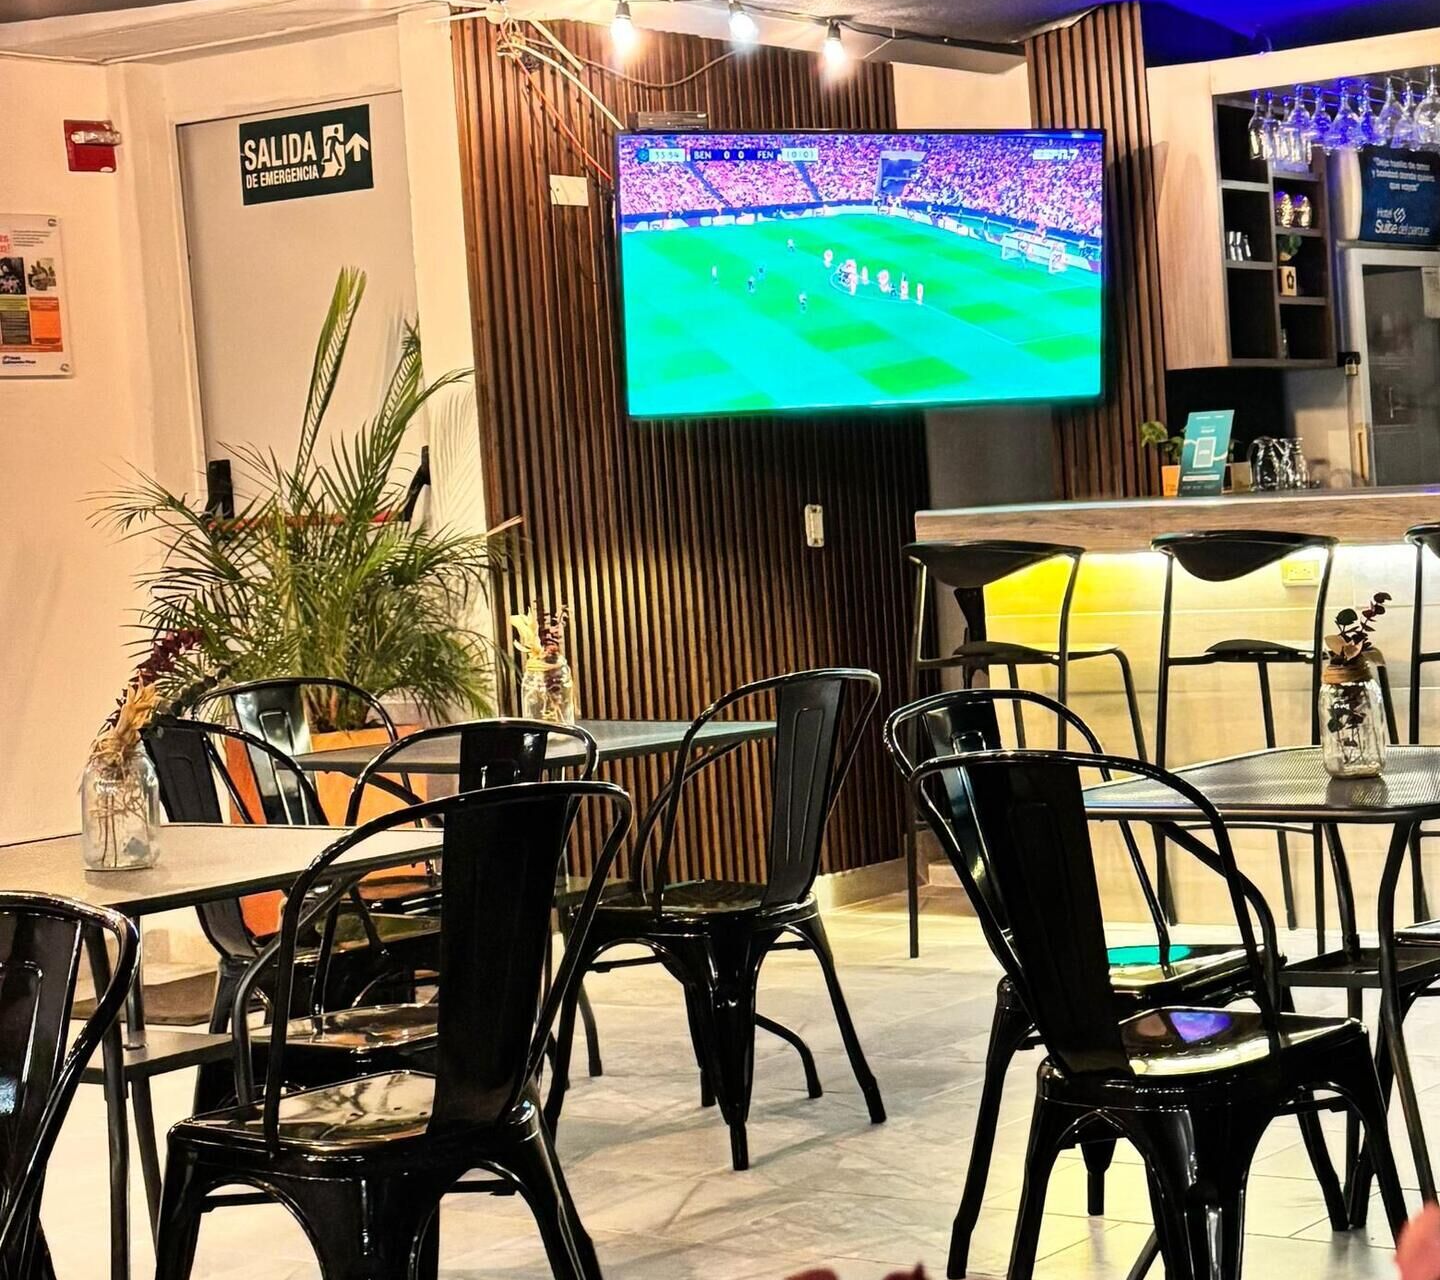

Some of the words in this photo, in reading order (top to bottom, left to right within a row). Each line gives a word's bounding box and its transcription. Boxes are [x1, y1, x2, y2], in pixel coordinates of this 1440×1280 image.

[244, 130, 317, 171] SALIDA
[694, 150, 711, 159] BEN
[723, 150, 730, 160] 0
[738, 150, 745, 160] 0
[757, 150, 774, 160] FEN
[246, 173, 259, 189] DE
[260, 164, 319, 187] EMERGENCIA
